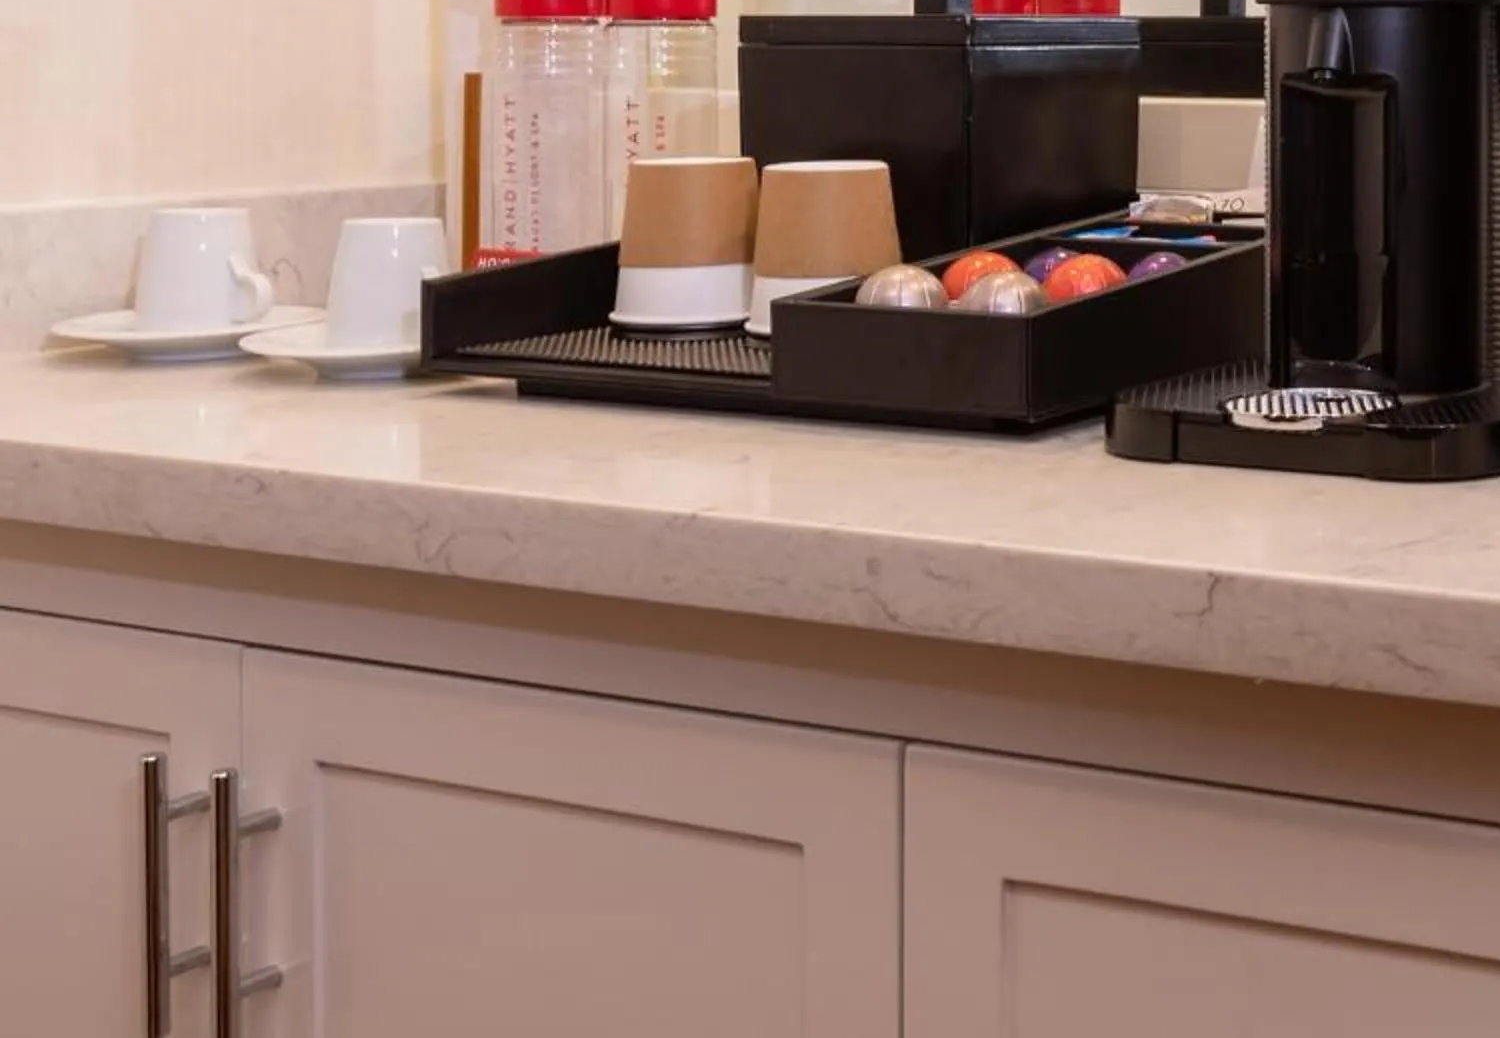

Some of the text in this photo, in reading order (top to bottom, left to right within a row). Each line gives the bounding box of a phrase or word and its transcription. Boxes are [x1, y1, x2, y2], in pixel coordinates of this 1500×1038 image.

[503, 96, 517, 255] RAND HYATT
[625, 97, 640, 161] YATT
